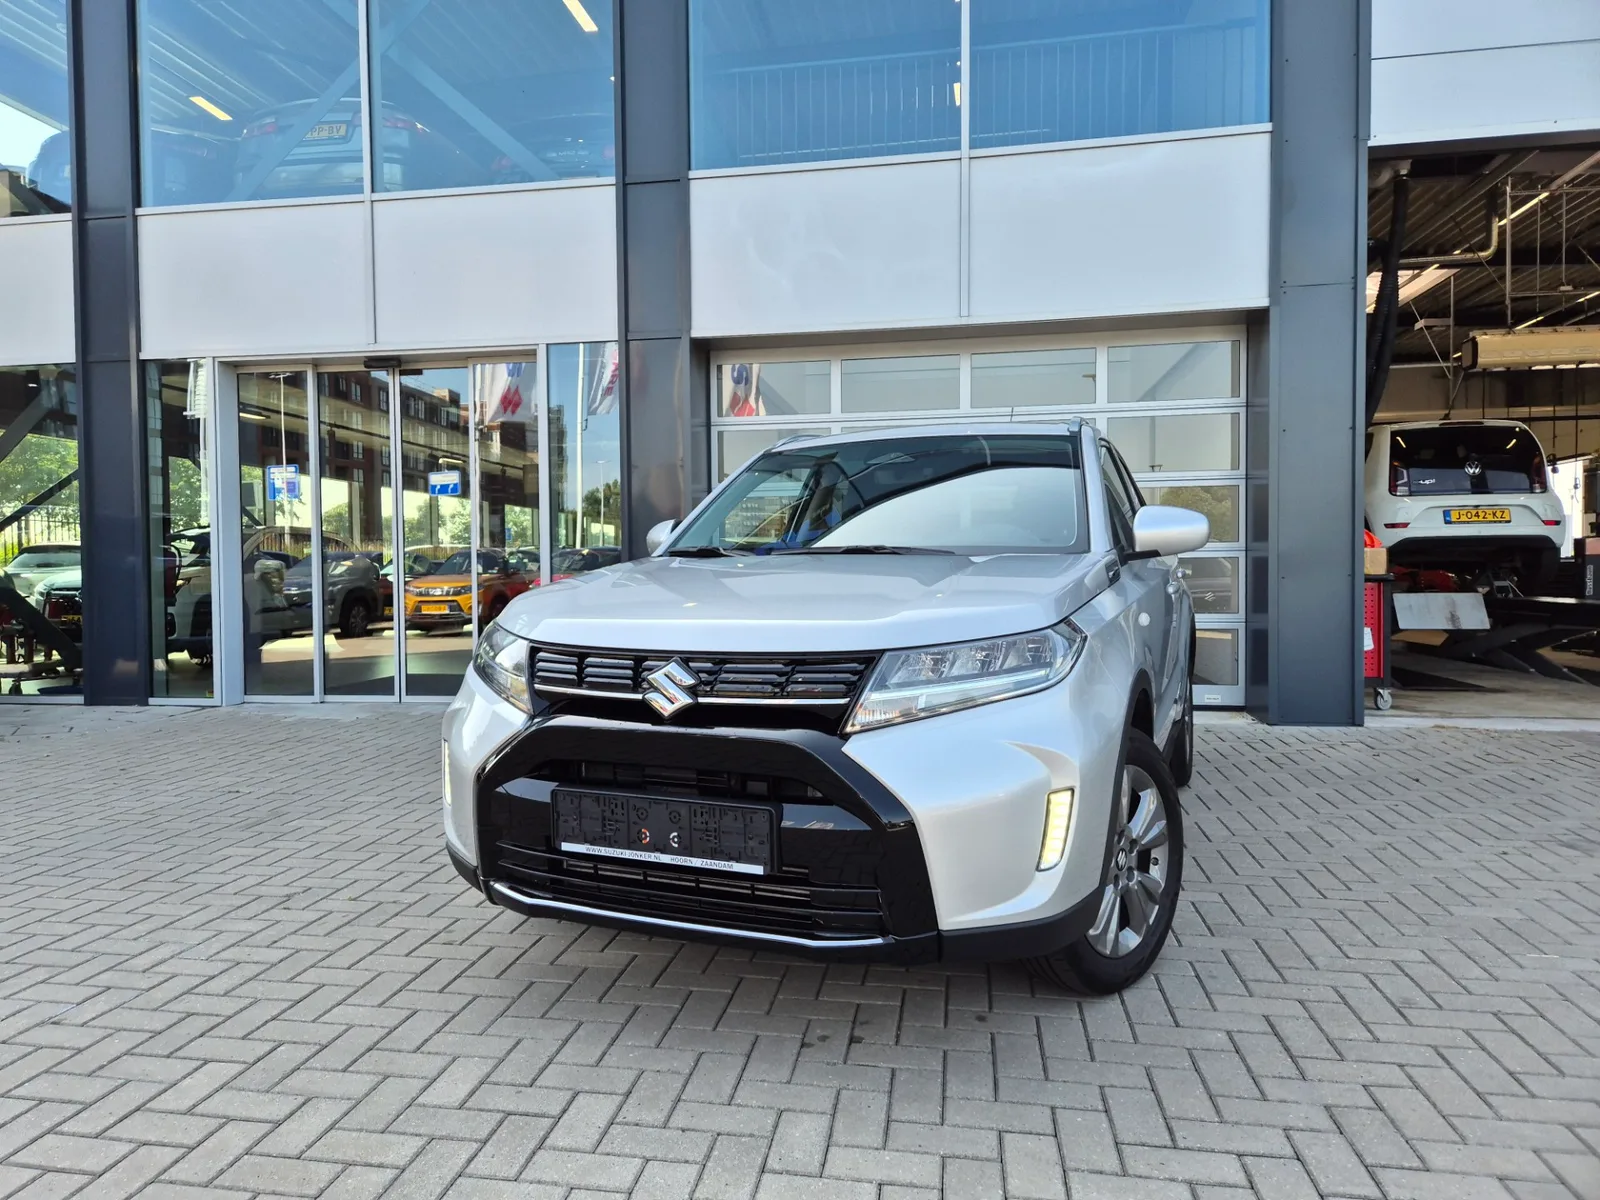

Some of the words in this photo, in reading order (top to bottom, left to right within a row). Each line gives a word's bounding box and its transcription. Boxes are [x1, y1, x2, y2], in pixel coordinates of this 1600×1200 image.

[1456, 510, 1506, 520] J-042-KZ
[670, 857, 693, 865] HOORN
[700, 860, 734, 870] ZAANDAM
